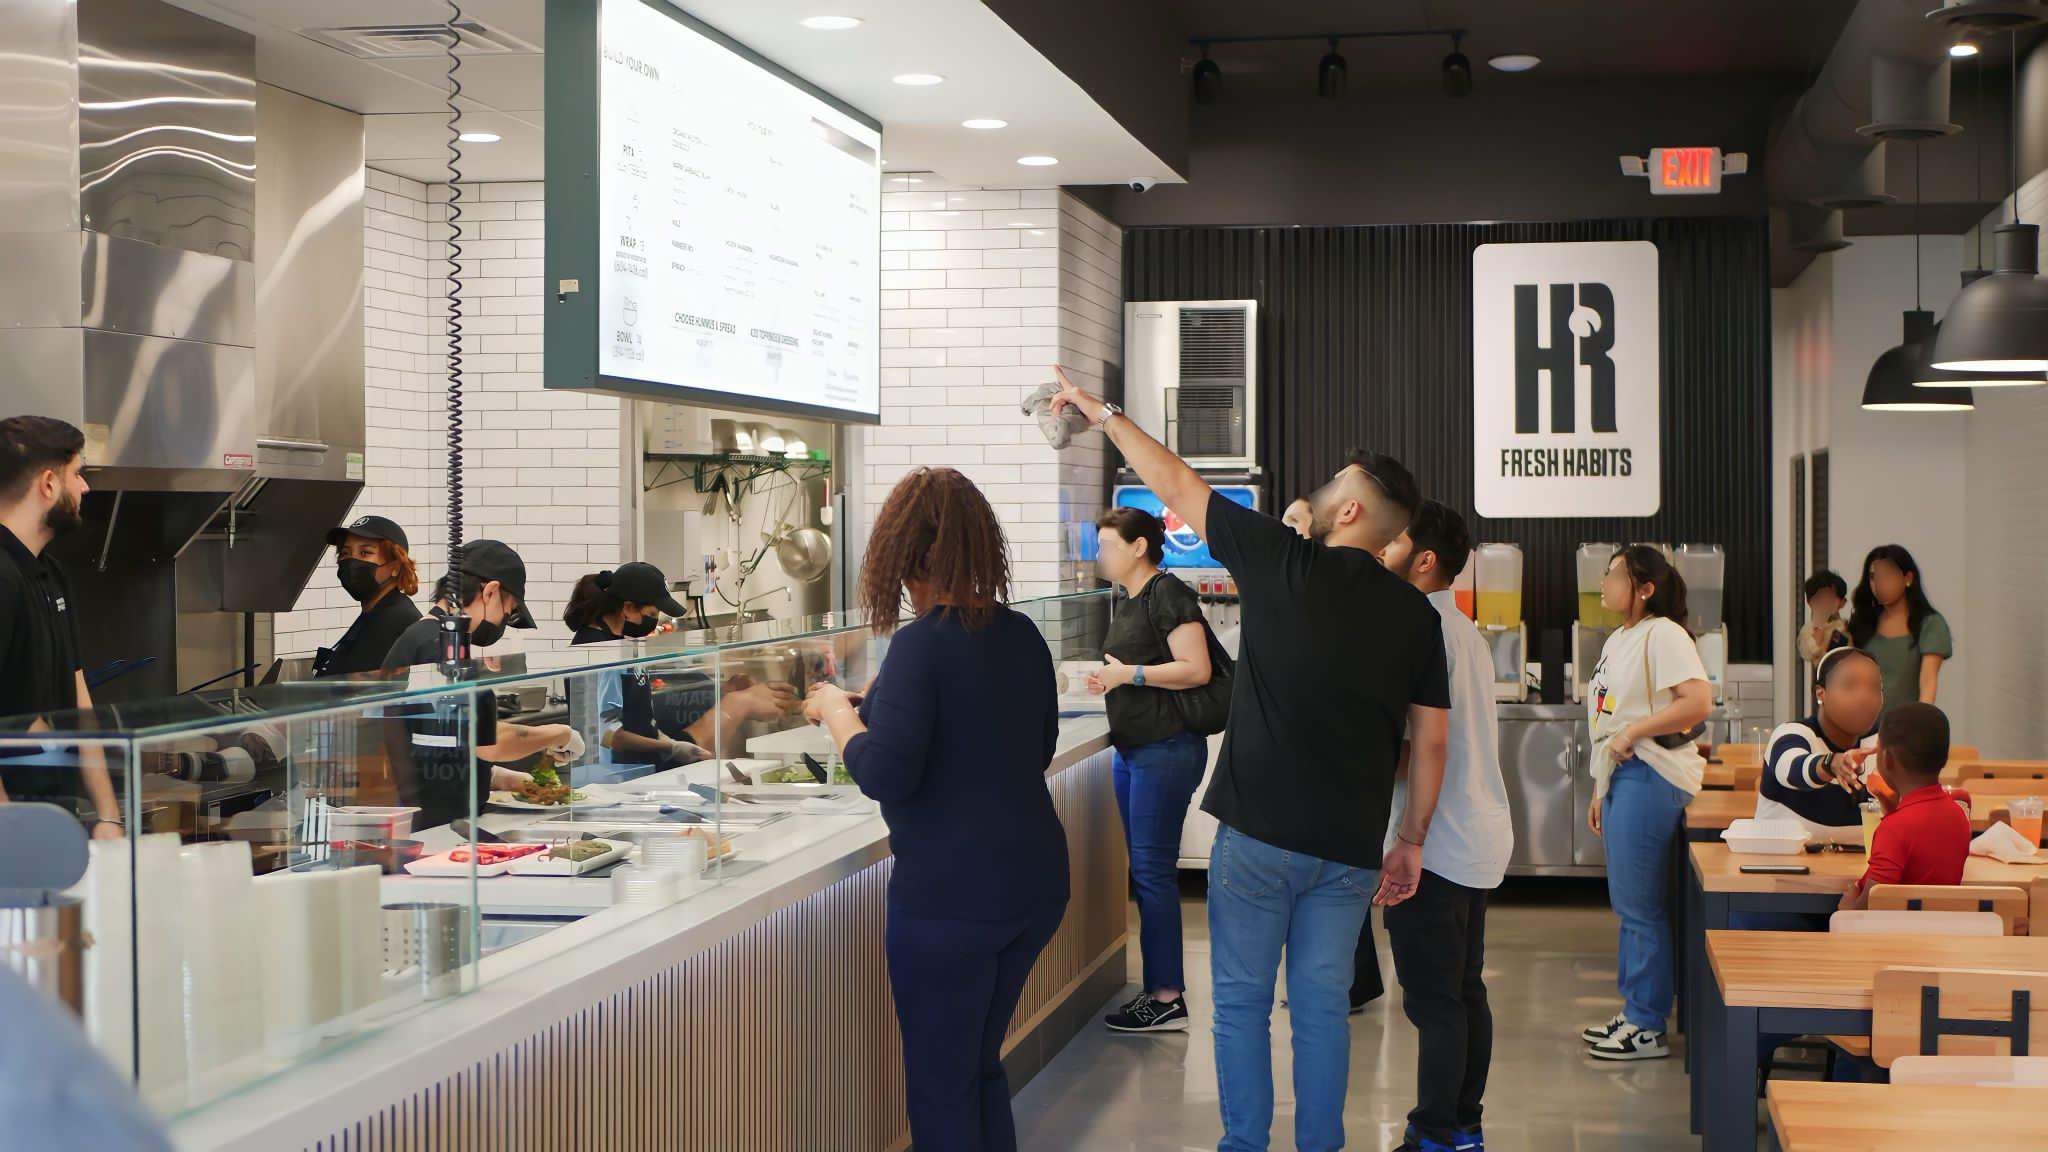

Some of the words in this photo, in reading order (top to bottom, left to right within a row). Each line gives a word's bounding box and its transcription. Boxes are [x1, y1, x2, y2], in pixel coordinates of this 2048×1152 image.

[1661, 148, 1713, 187] EXIT
[674, 311, 695, 327] CHOOSE
[616, 329, 633, 345] BOWL
[1501, 448, 1559, 477] FRESH
[1563, 448, 1632, 477] HABITS
